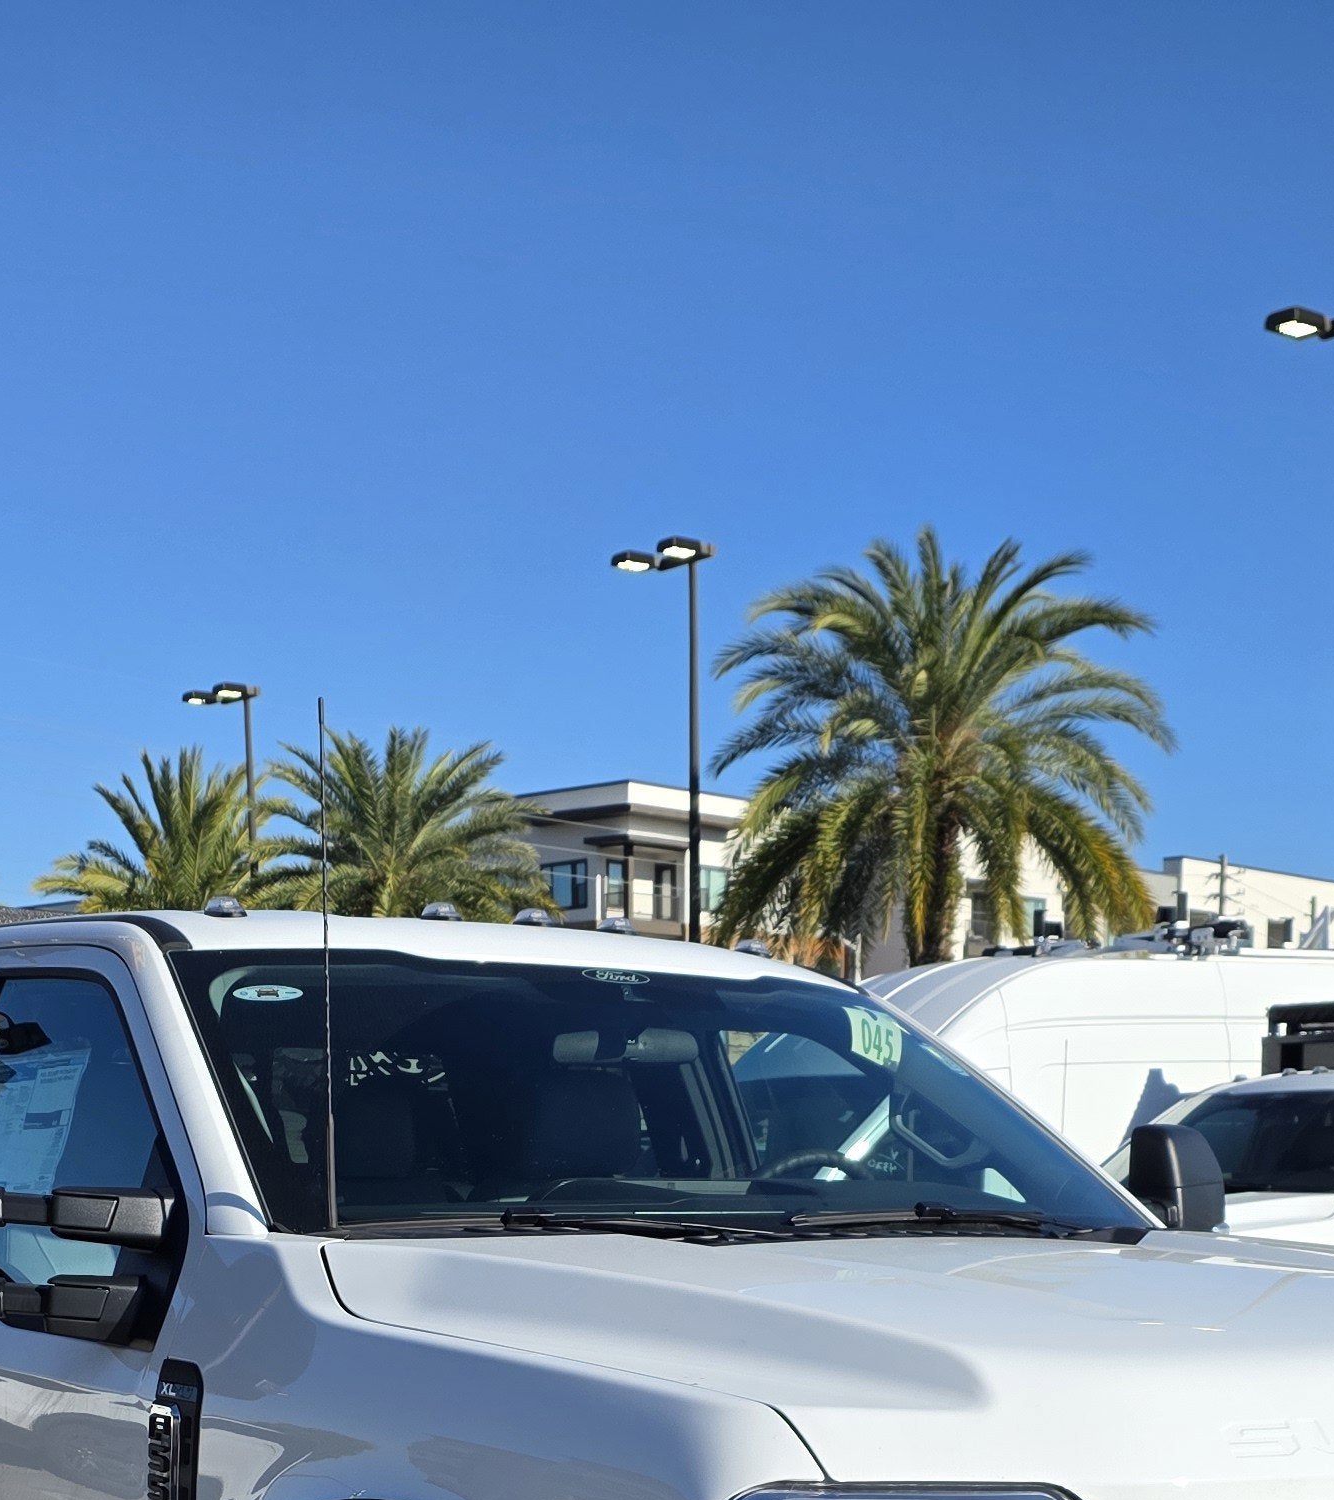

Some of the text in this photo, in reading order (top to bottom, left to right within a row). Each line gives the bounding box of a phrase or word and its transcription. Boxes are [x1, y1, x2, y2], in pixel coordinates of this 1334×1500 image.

[595, 970, 639, 982] Ford
[861, 1018, 895, 1064] 045
[160, 1381, 176, 1397] XL
